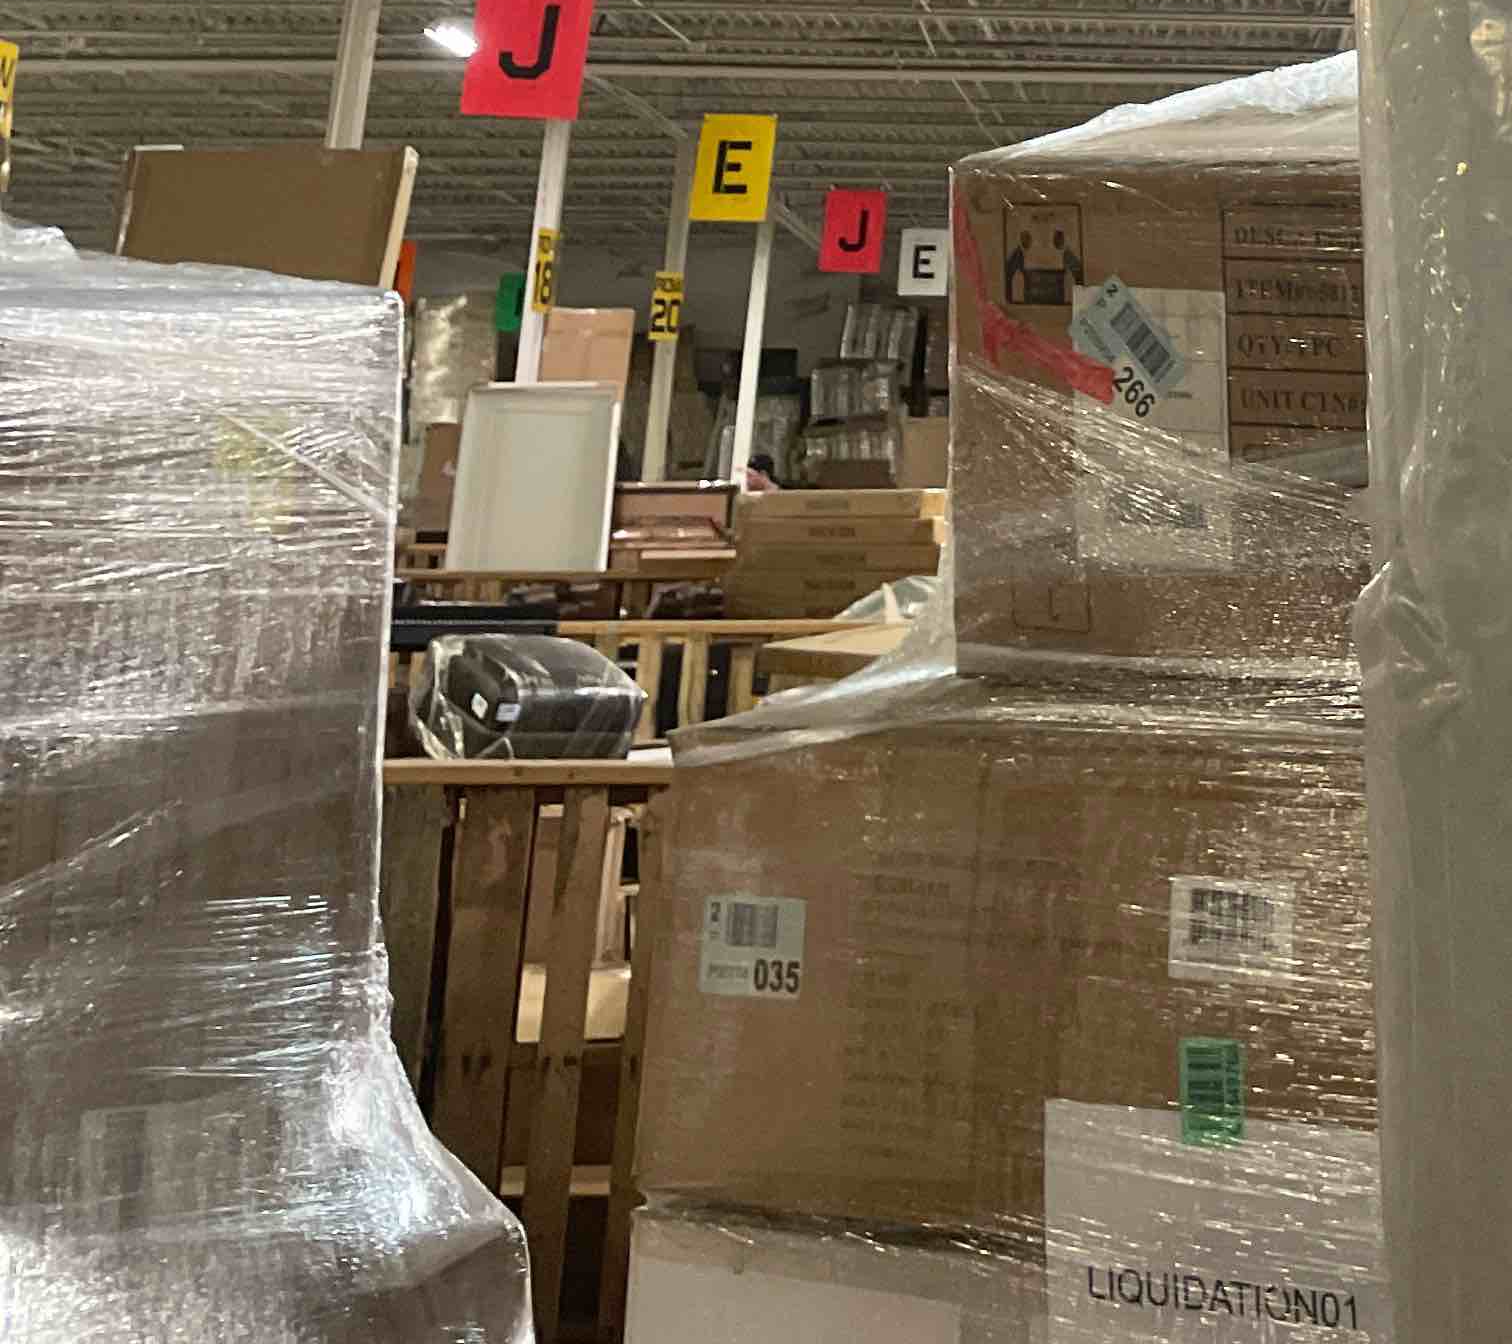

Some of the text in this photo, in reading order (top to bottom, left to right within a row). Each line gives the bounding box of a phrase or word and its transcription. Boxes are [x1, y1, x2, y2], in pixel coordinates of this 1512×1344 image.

[498, 4, 561, 80] J
[711, 140, 753, 195] E
[837, 209, 869, 253] J
[913, 245, 937, 279] E
[651, 298, 681, 333] 20
[1112, 366, 1155, 418] 266
[1240, 387, 1296, 411] UNIT
[754, 959, 800, 994] 035
[1087, 1265, 1358, 1329] LIQUIDATION01
